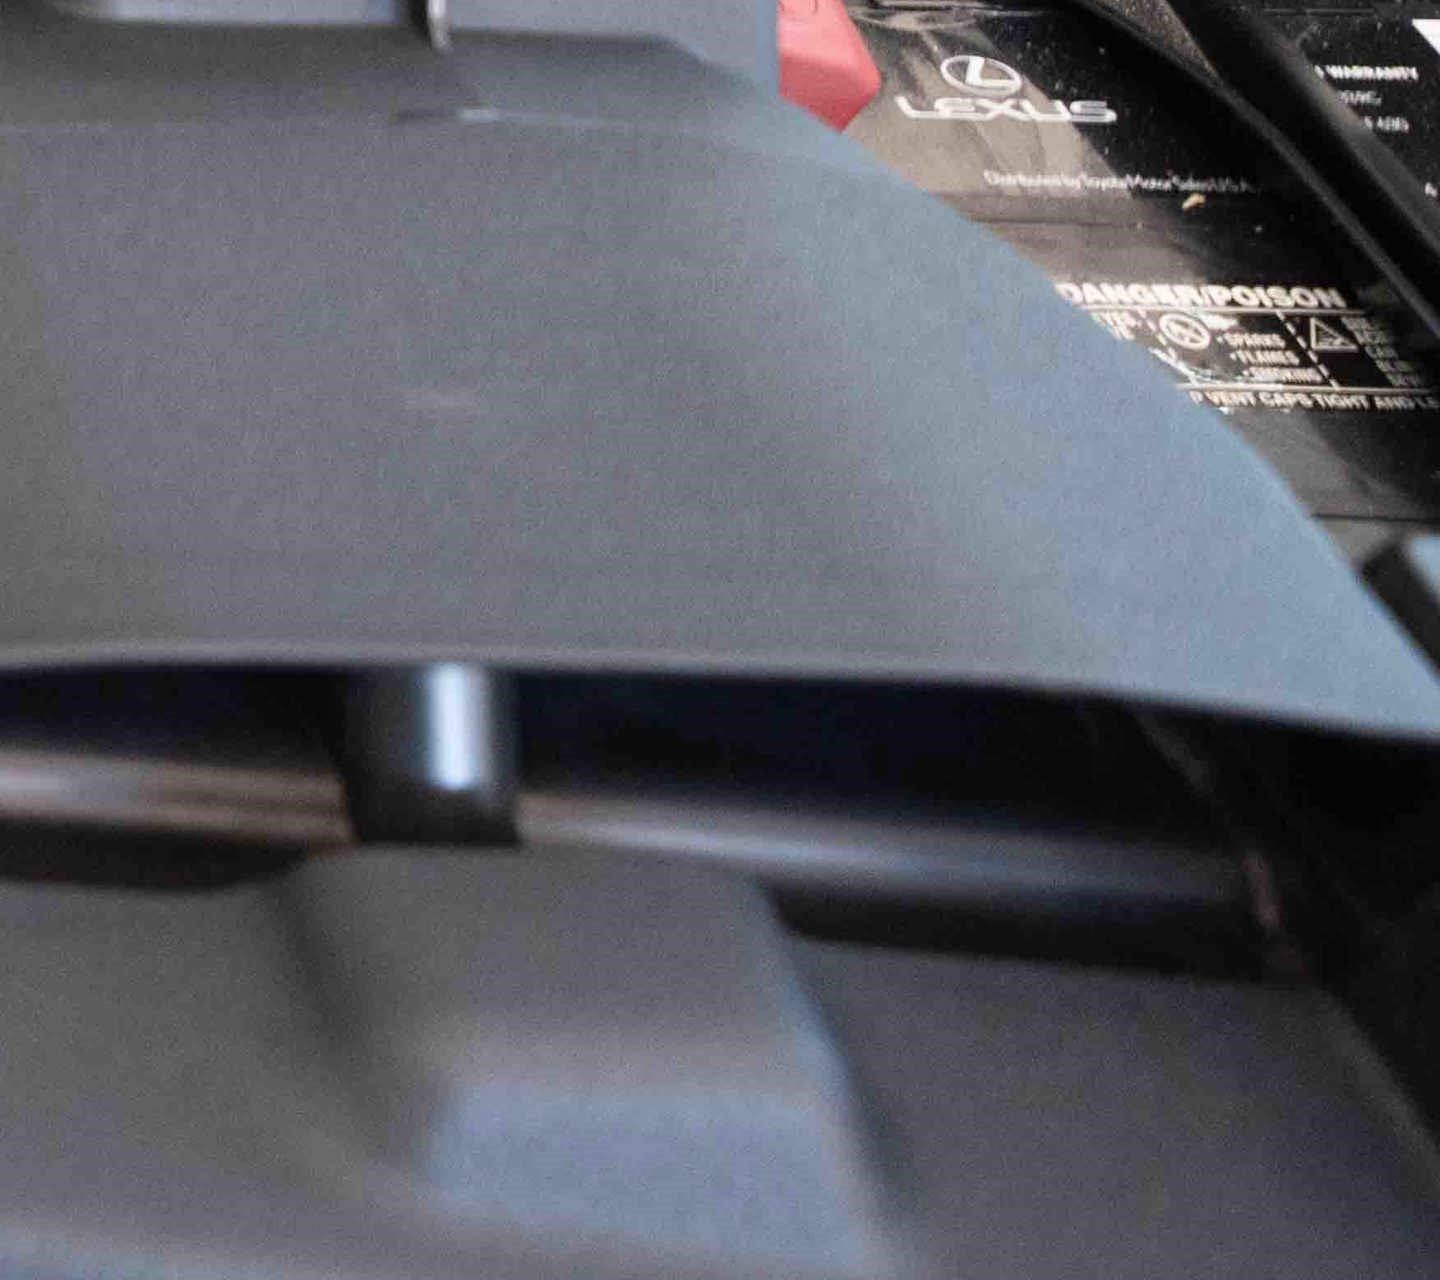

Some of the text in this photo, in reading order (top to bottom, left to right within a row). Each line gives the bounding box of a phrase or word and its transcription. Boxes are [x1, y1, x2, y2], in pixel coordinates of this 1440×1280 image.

[894, 95, 1118, 122] LEXUS
[1056, 282, 1347, 308] DANGER/POISON
[1204, 391, 1256, 407] VENT
[1258, 392, 1314, 408] CAPS
[1311, 393, 1371, 409] TIGHT
